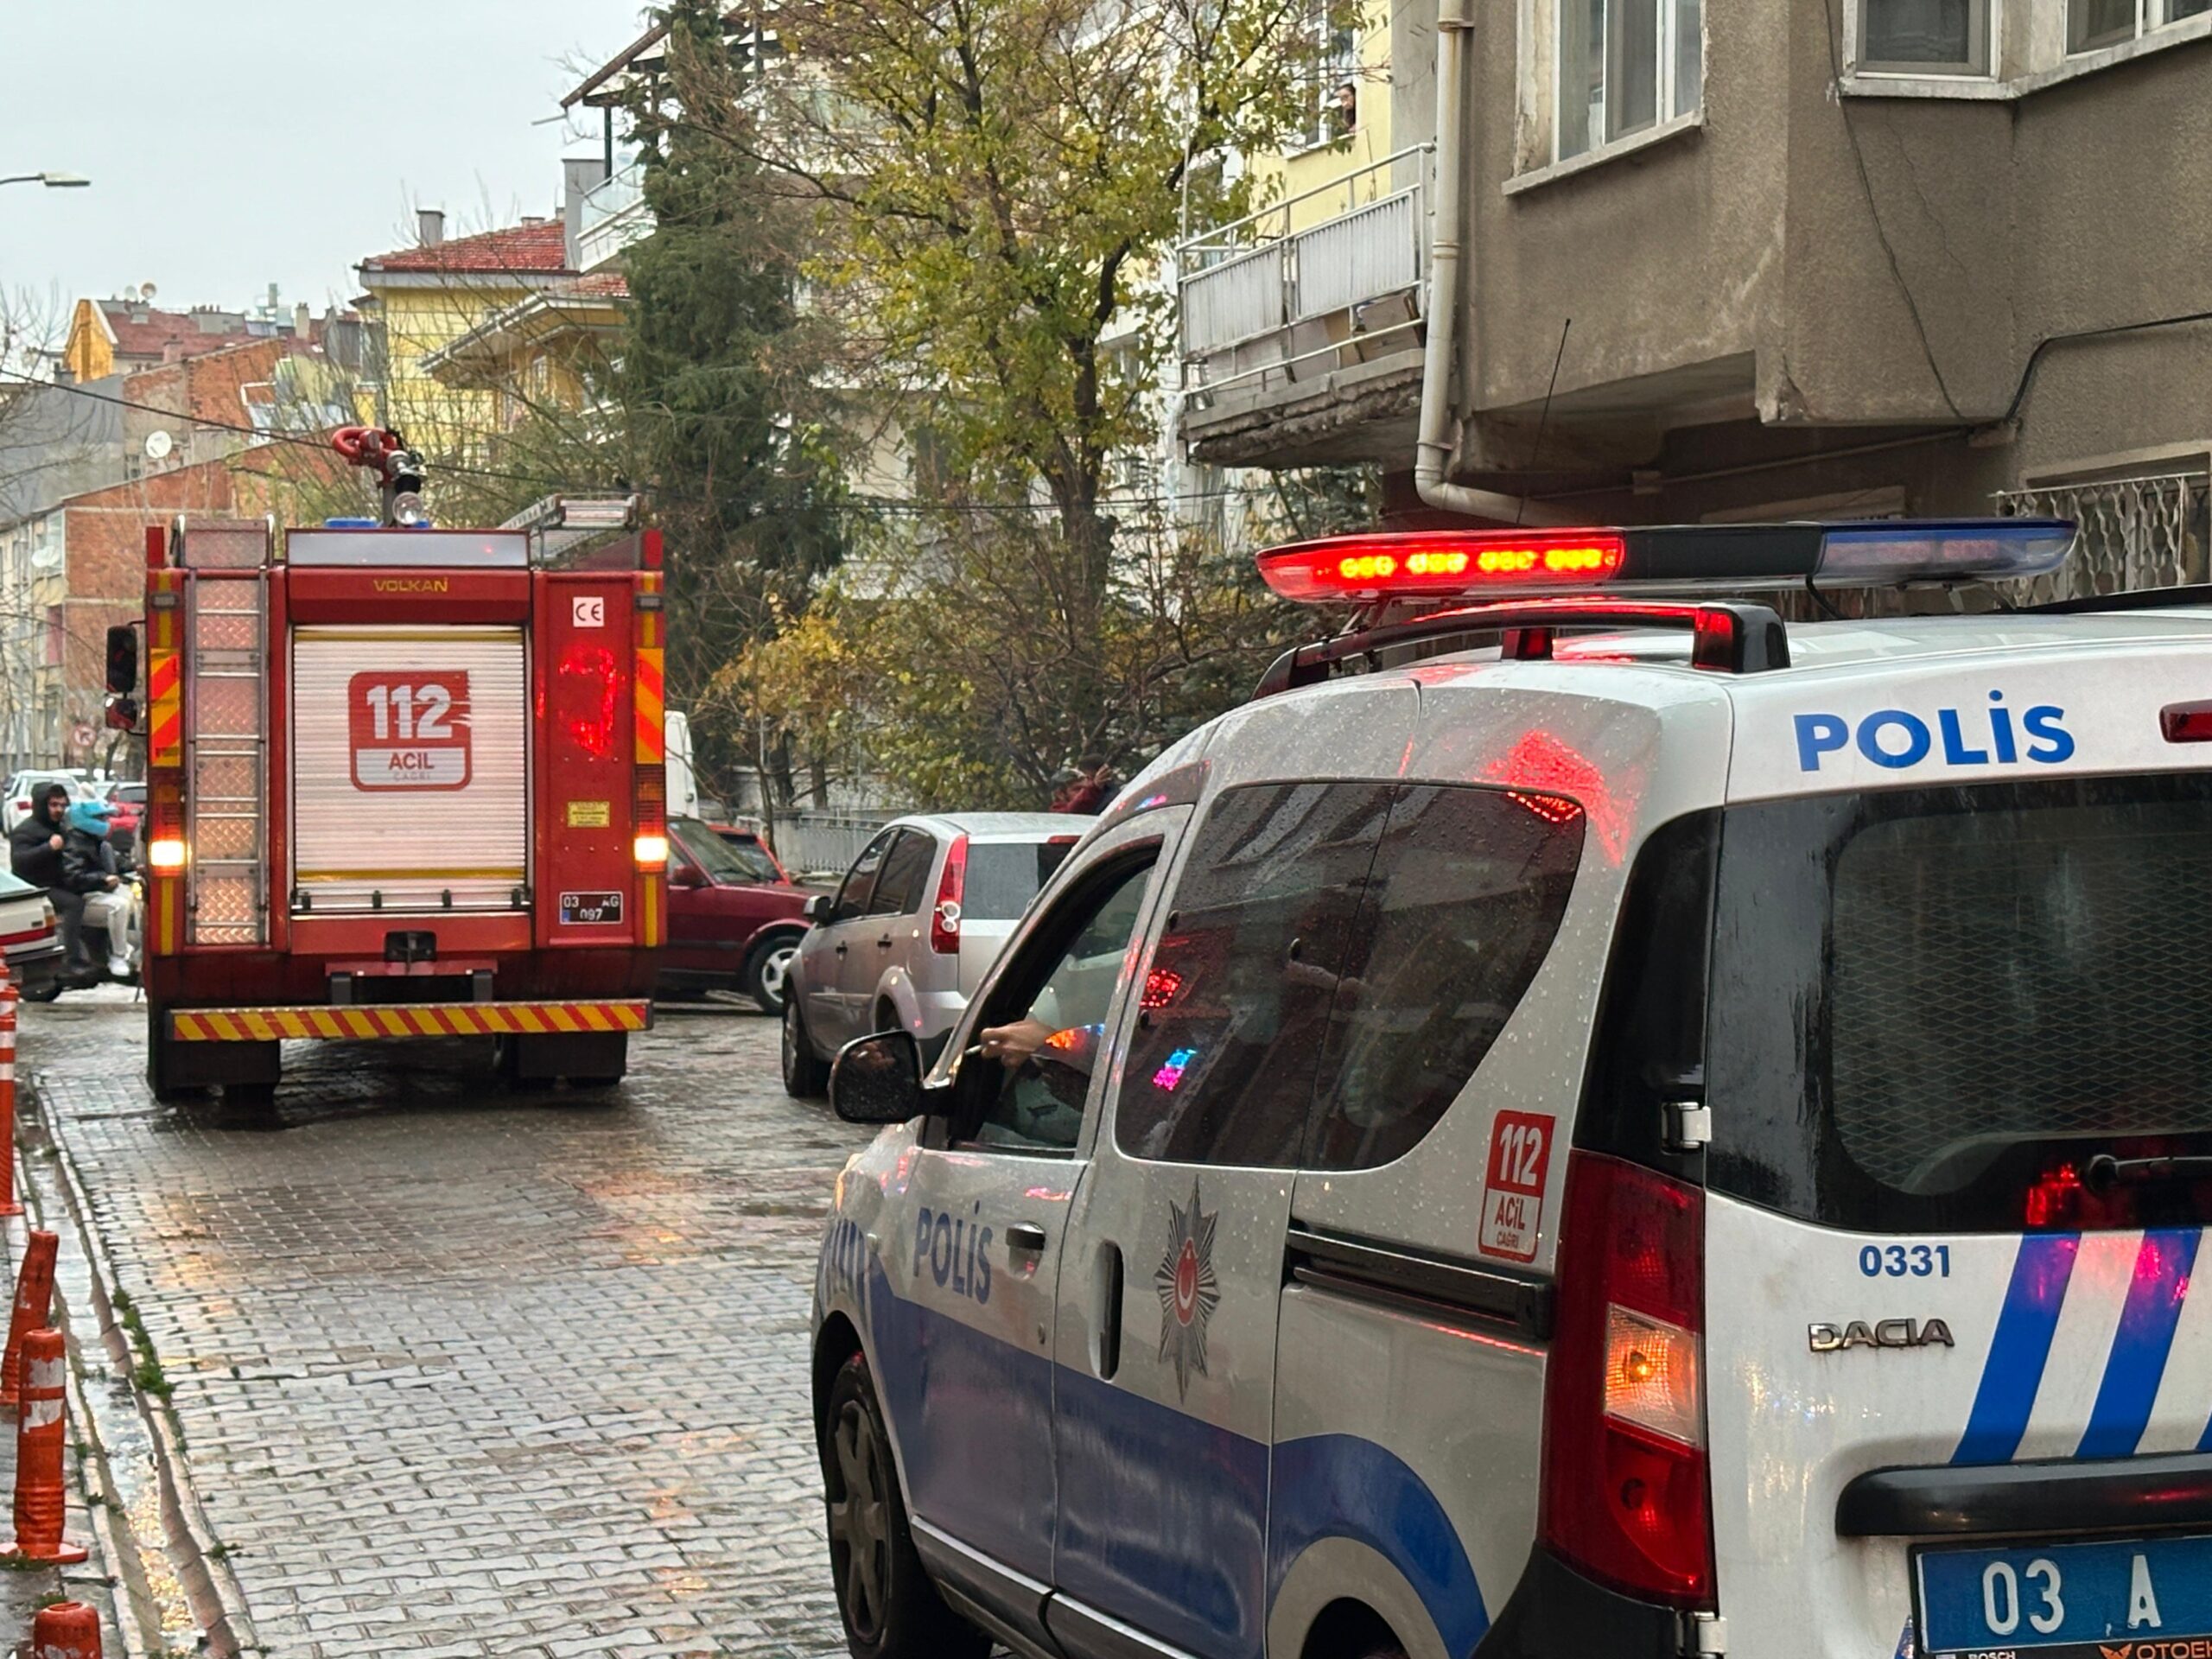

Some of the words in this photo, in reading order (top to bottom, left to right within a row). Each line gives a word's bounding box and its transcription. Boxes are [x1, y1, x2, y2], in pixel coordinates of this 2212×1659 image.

[366, 684, 453, 740] 112
[1793, 690, 2075, 772] POLİS
[563, 896, 579, 908] 03
[1499, 1123, 1542, 1186] 112
[913, 1200, 993, 1305] POLİS
[1859, 1245, 1949, 1277] 0331
[1808, 1318, 1955, 1352] DACIA
[1983, 1559, 2064, 1635] 03
[2127, 1554, 2161, 1629] A
